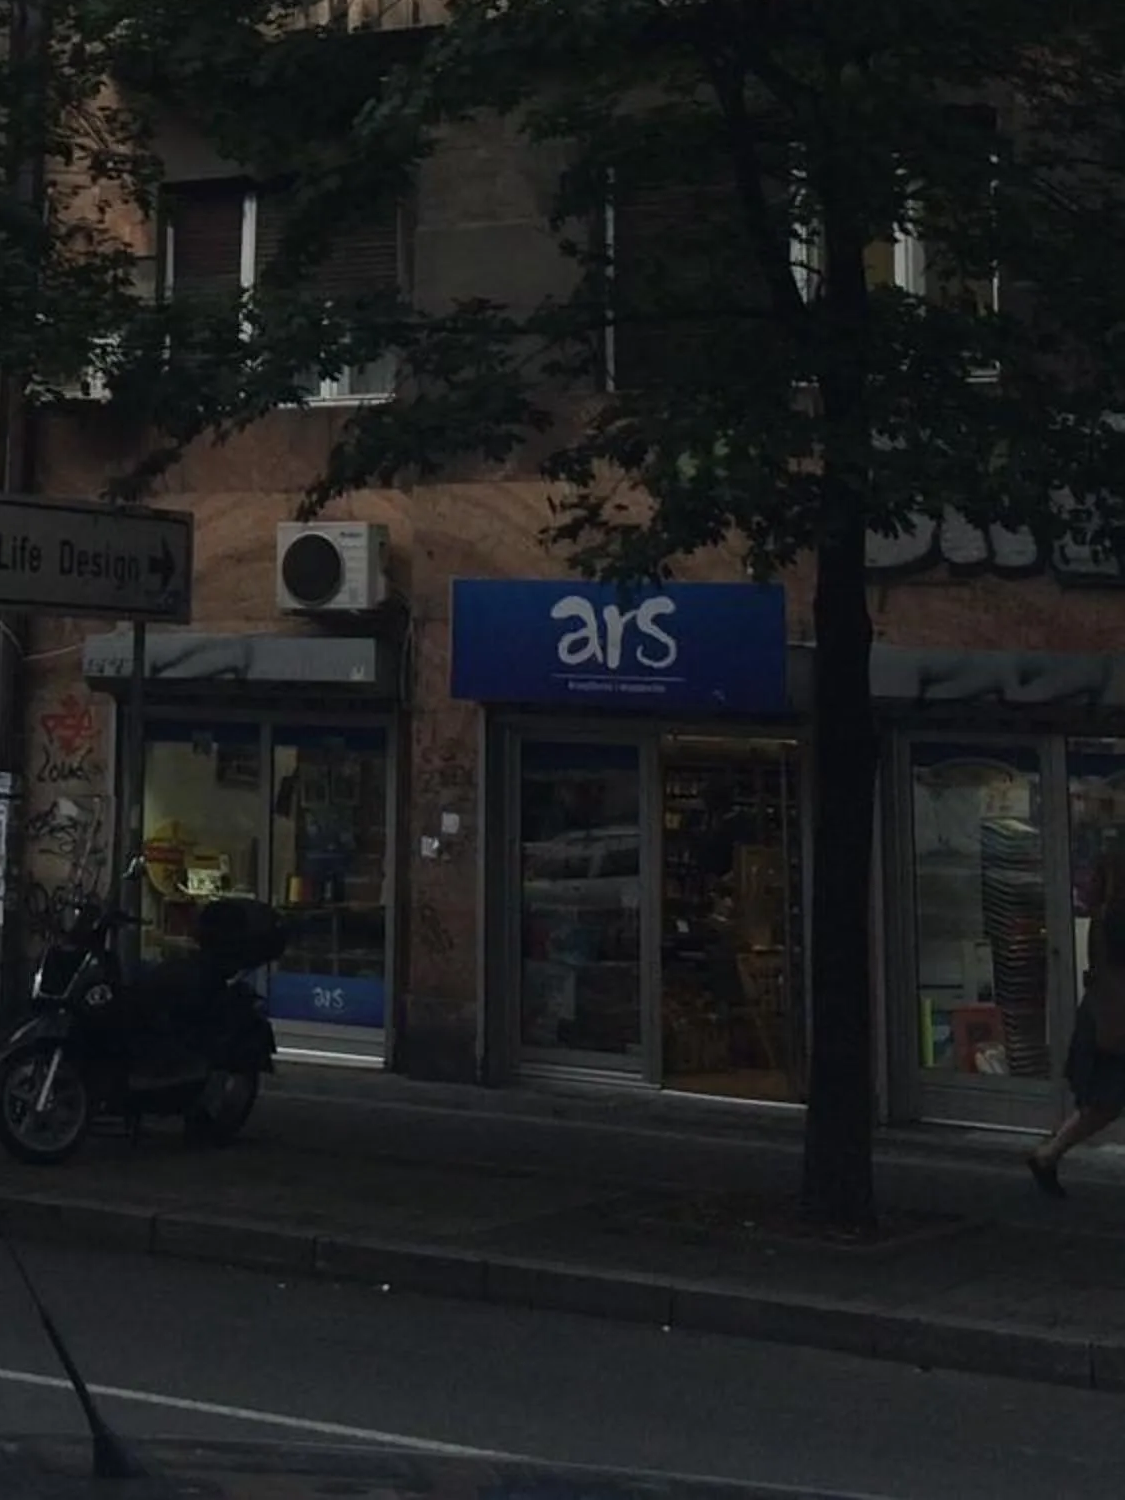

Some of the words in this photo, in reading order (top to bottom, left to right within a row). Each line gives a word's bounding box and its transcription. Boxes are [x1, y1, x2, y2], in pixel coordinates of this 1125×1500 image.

[59, 539, 140, 590] Design
[550, 595, 677, 669] ars
[312, 986, 347, 1009] ars
